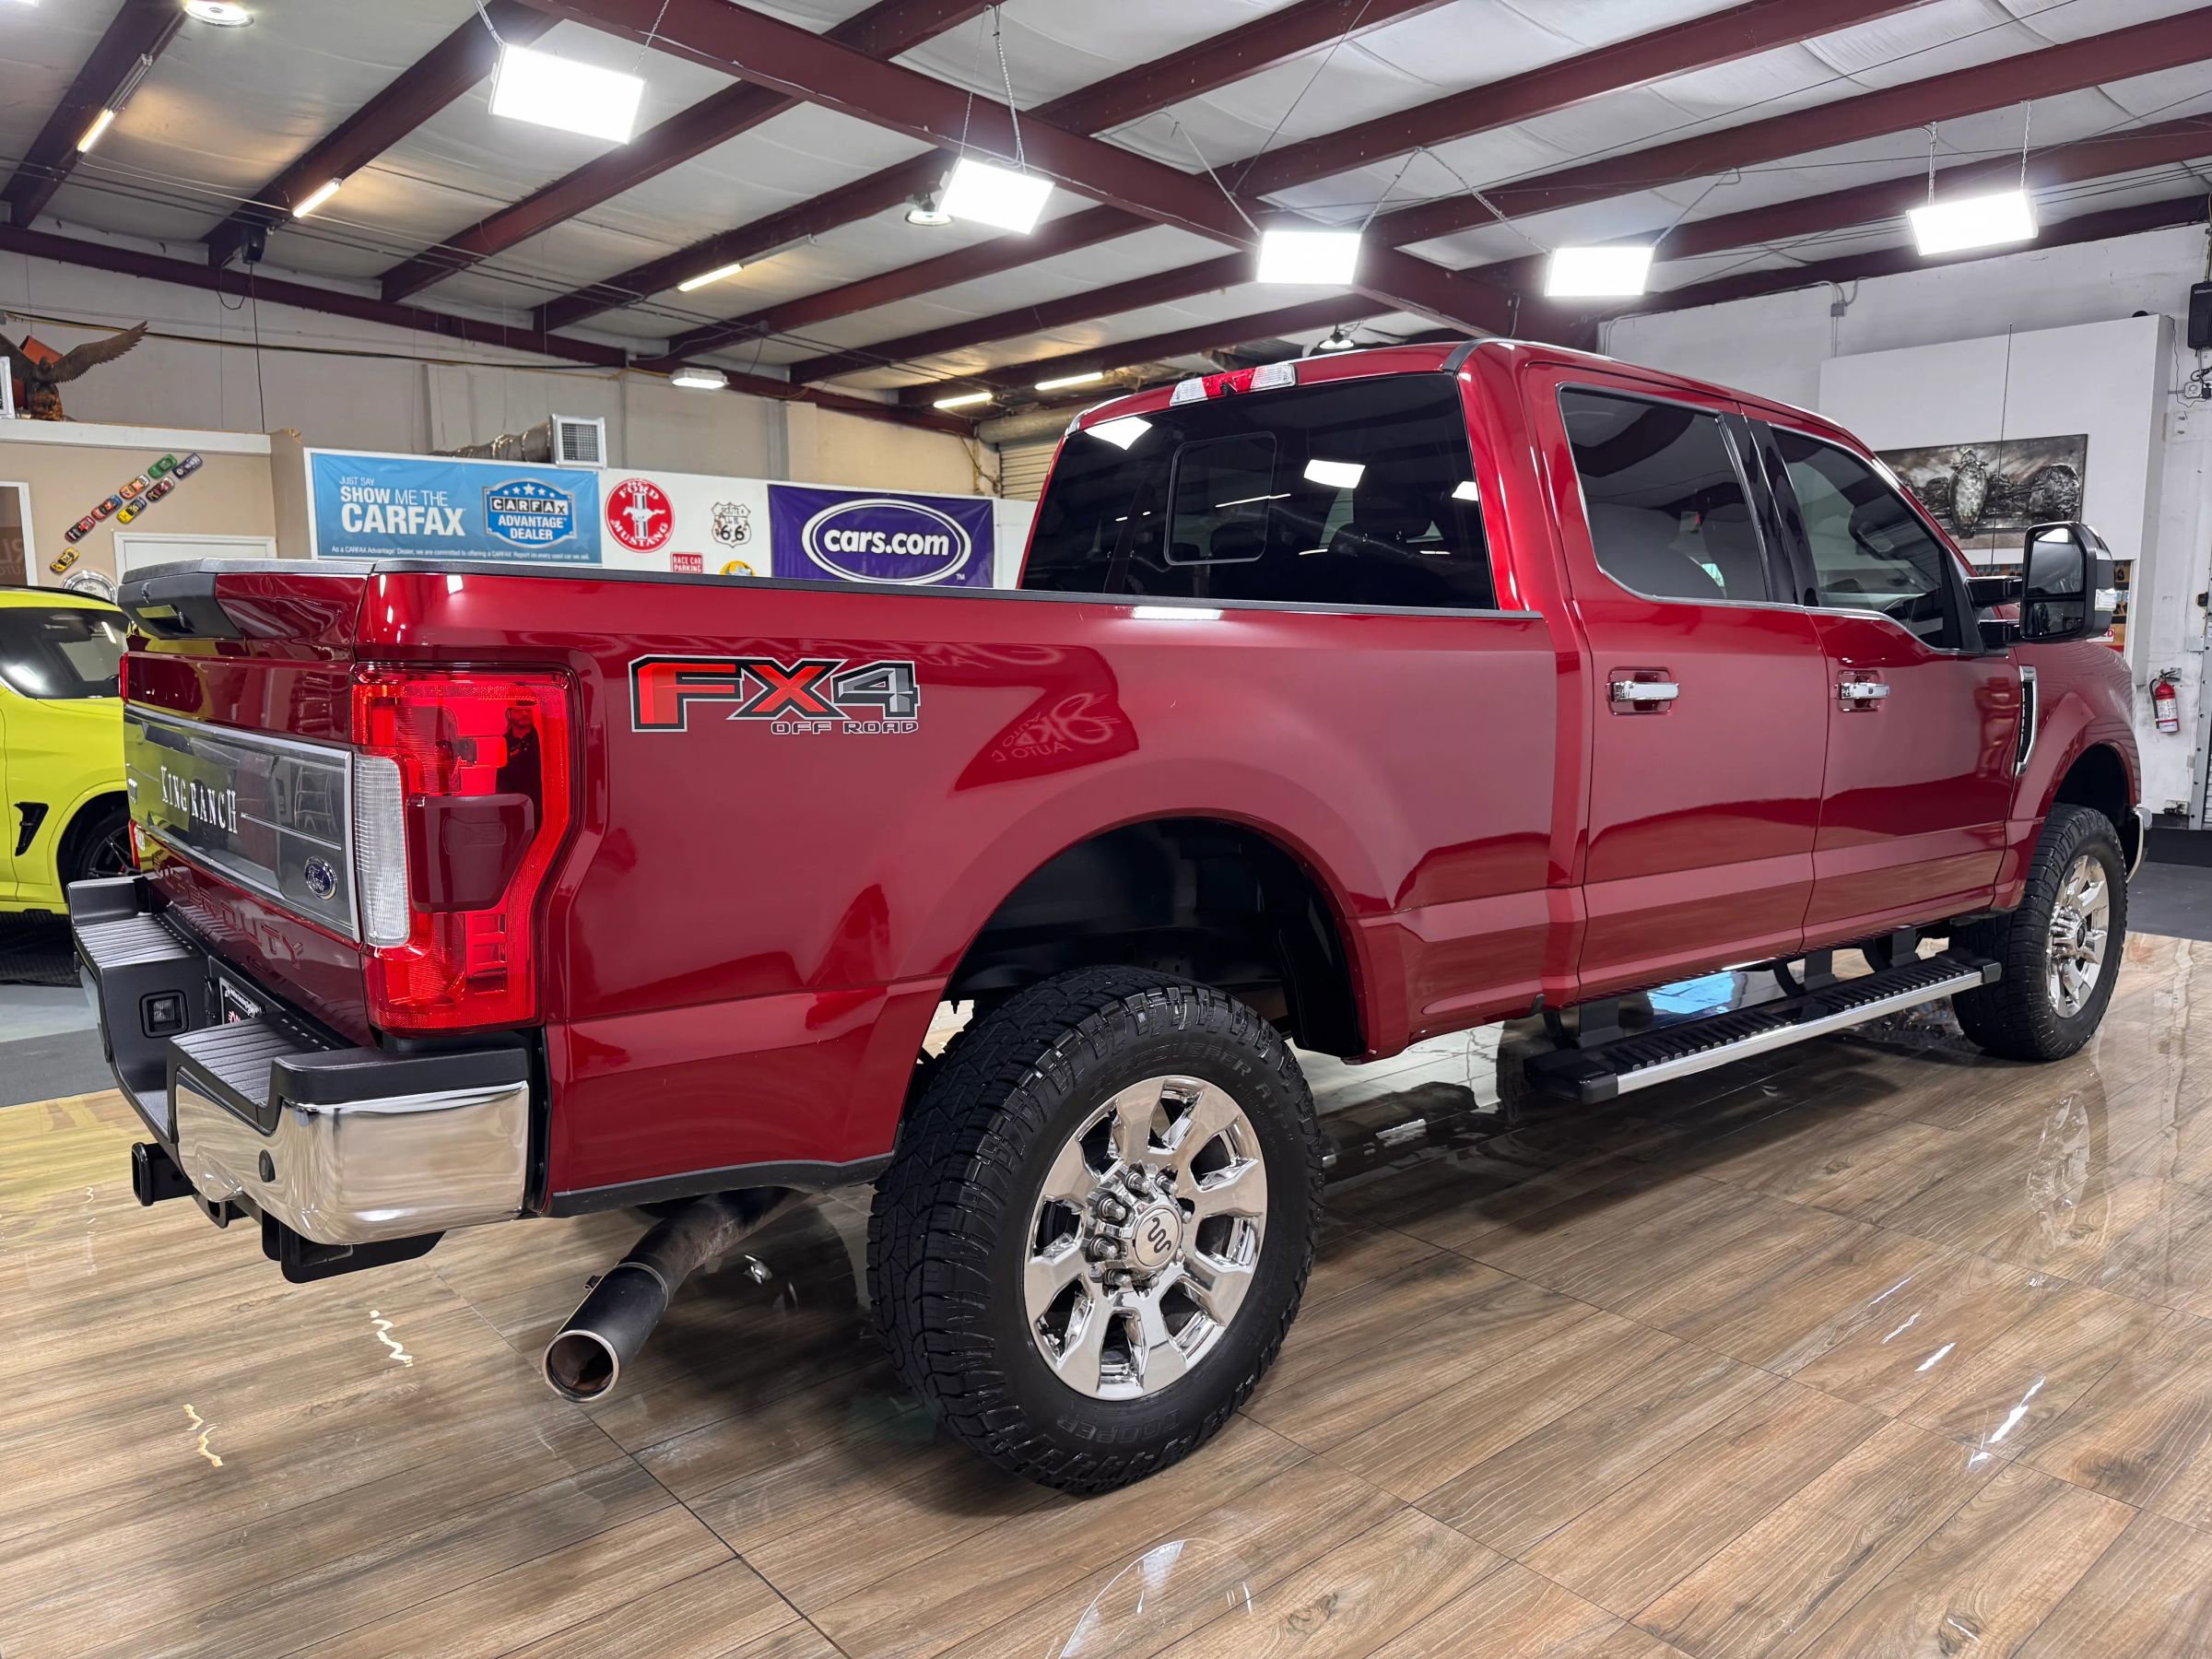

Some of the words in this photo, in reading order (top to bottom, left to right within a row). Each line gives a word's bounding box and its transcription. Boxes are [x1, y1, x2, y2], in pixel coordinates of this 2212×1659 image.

[339, 477, 359, 486] JUST
[360, 477, 375, 487] SAY
[340, 486, 391, 503] SHOW
[394, 489, 420, 505] ME
[421, 490, 448, 507] THE
[618, 483, 660, 500] FORD
[492, 499, 566, 514] CARFAX
[341, 502, 465, 536] CARFAX
[498, 514, 564, 529] ADVANTAGE
[510, 527, 554, 541] DEALER
[610, 518, 669, 547] MUSTANG
[721, 524, 745, 541] 66
[823, 529, 949, 556] cars.com
[674, 556, 688, 564] RACE
[689, 557, 701, 565] CAR
[674, 564, 701, 573] PARKING
[629, 654, 921, 733] FX4
[771, 721, 832, 735] OFF
[842, 721, 920, 735] ROAD
[159, 764, 188, 812] KING
[190, 780, 239, 834] RANCH
[221, 898, 305, 964] DUTY
[1056, 1408, 1182, 1444] COOPER
